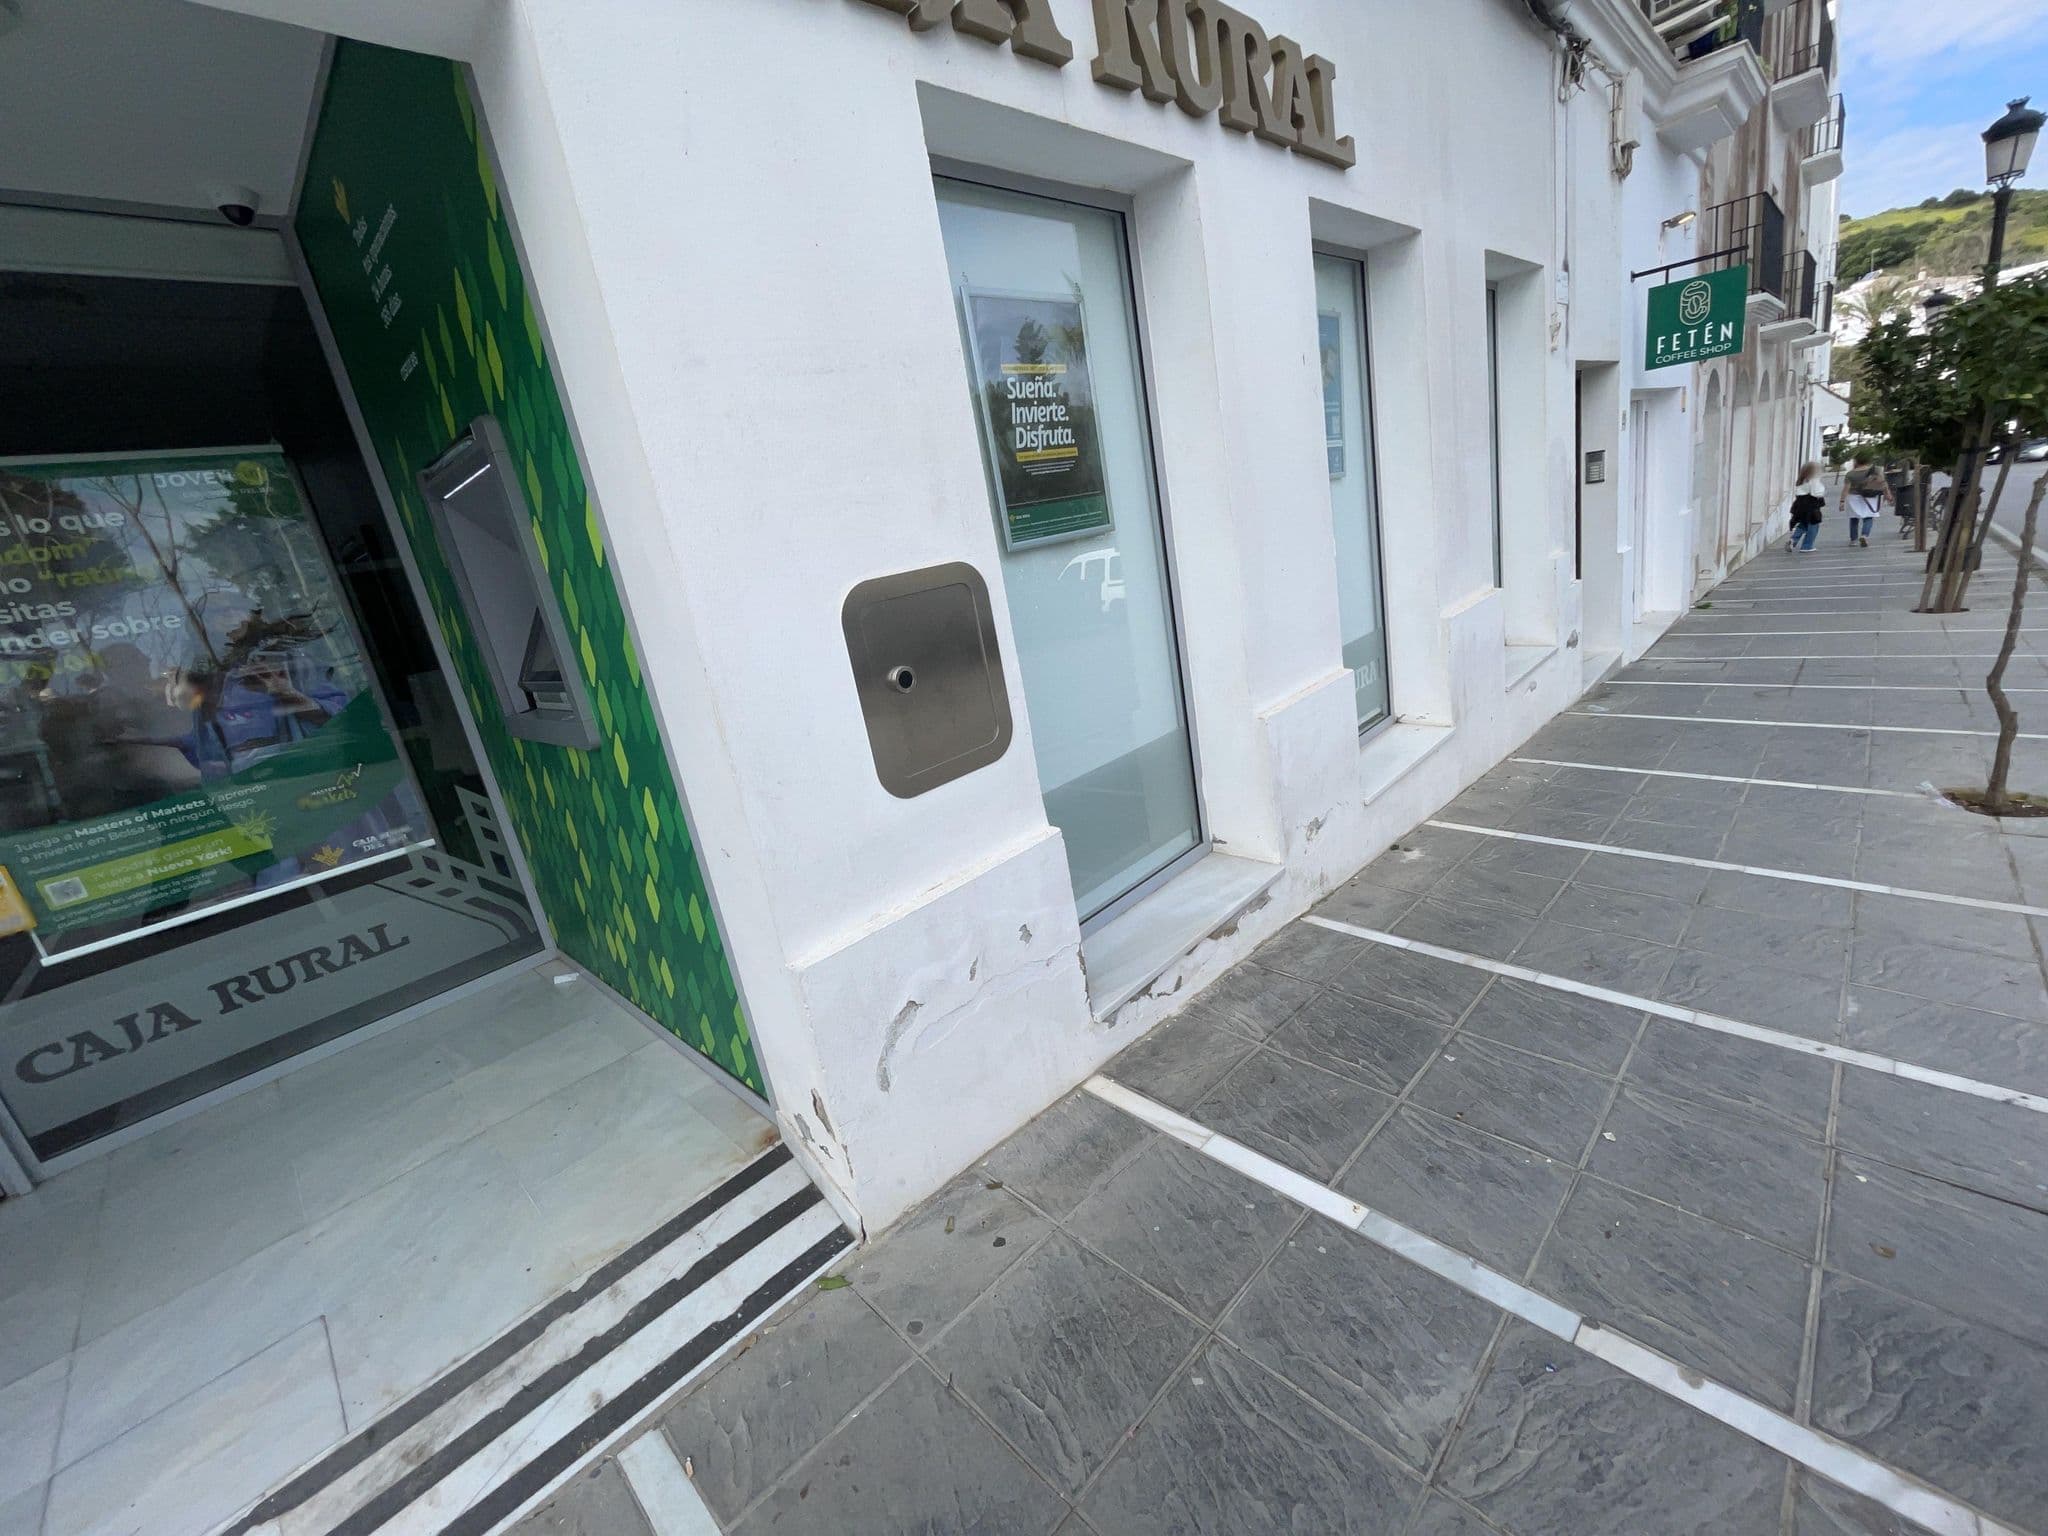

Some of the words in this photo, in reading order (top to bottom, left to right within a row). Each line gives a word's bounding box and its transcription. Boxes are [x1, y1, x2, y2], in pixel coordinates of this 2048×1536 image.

[1657, 321, 1733, 354] FETÉN
[1656, 349, 1697, 364] COFFEE
[1700, 343, 1732, 356] SHOP
[1007, 376, 1057, 399] Sueña.
[1011, 401, 1069, 424] Invierte.
[1016, 424, 1075, 453] Disfruta.
[15, 514, 51, 535] lo
[59, 510, 125, 534] que
[91, 614, 182, 640] sobre
[75, 817, 133, 838] Masters
[134, 812, 149, 824] of
[151, 798, 205, 819] Markets
[214, 783, 267, 803] aprende
[108, 824, 145, 841] Bolsa
[170, 806, 215, 825] ningún
[148, 857, 194, 877] Nueva
[199, 846, 233, 863] York!
[15, 1002, 202, 1084] CAJA
[207, 923, 410, 1015] RURAL
